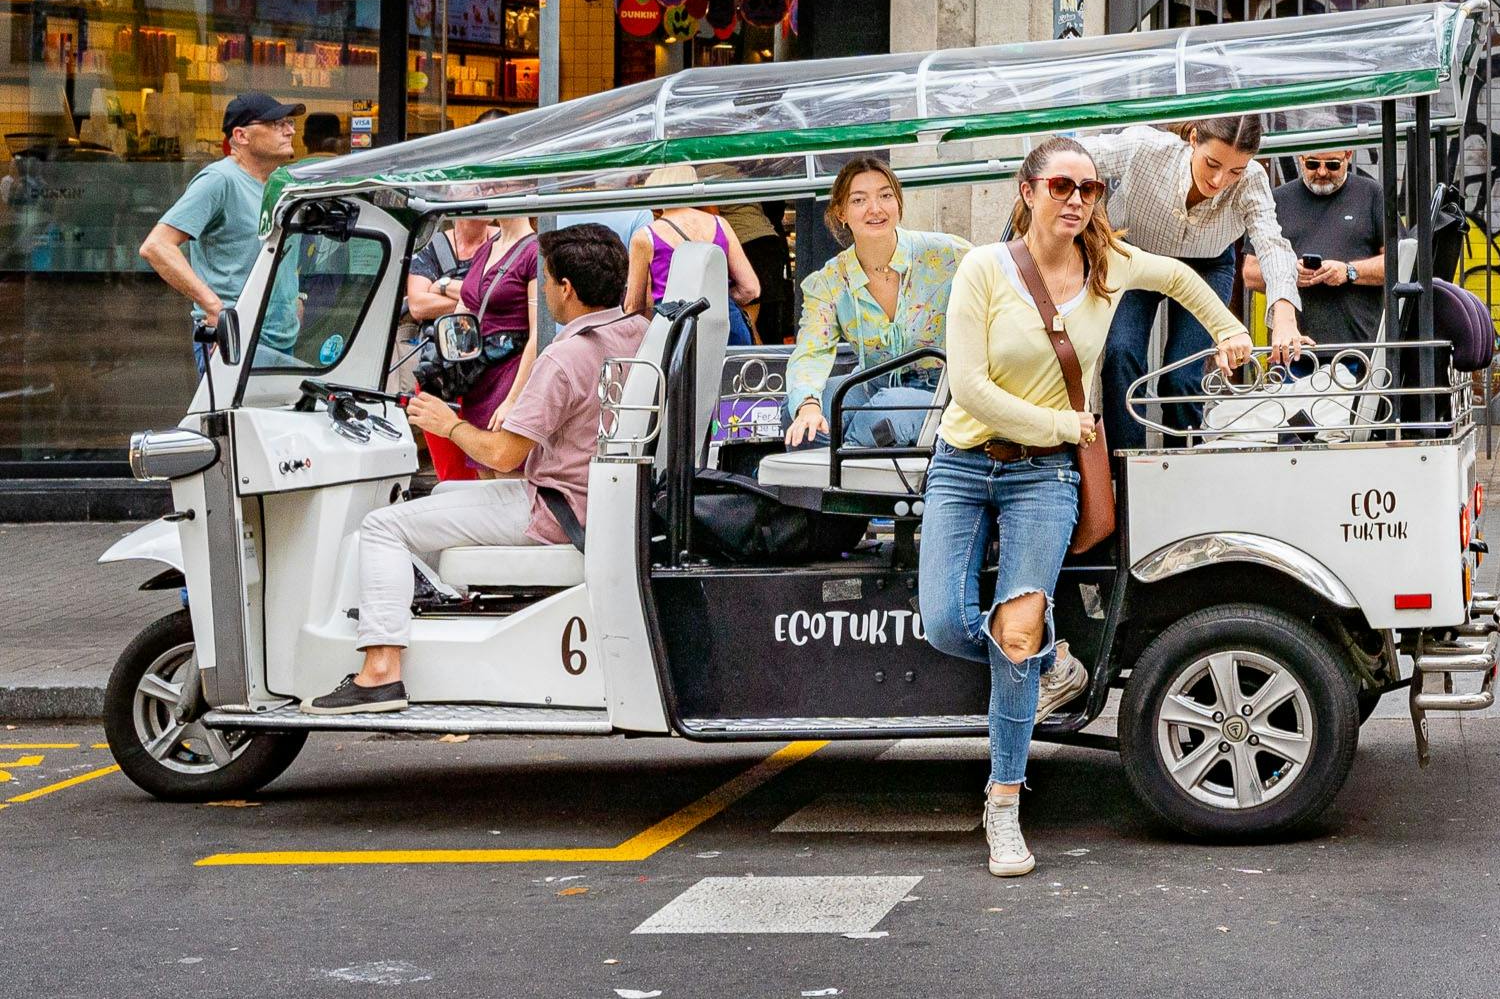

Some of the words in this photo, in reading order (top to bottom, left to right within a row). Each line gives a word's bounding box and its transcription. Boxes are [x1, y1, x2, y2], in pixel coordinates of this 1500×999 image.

[621, 10, 659, 20] DUNKIN'
[1351, 488, 1396, 519] ECO
[1340, 521, 1408, 542] TUKTUK
[774, 609, 929, 647] ECOTUKTU
[561, 615, 588, 676] 6
